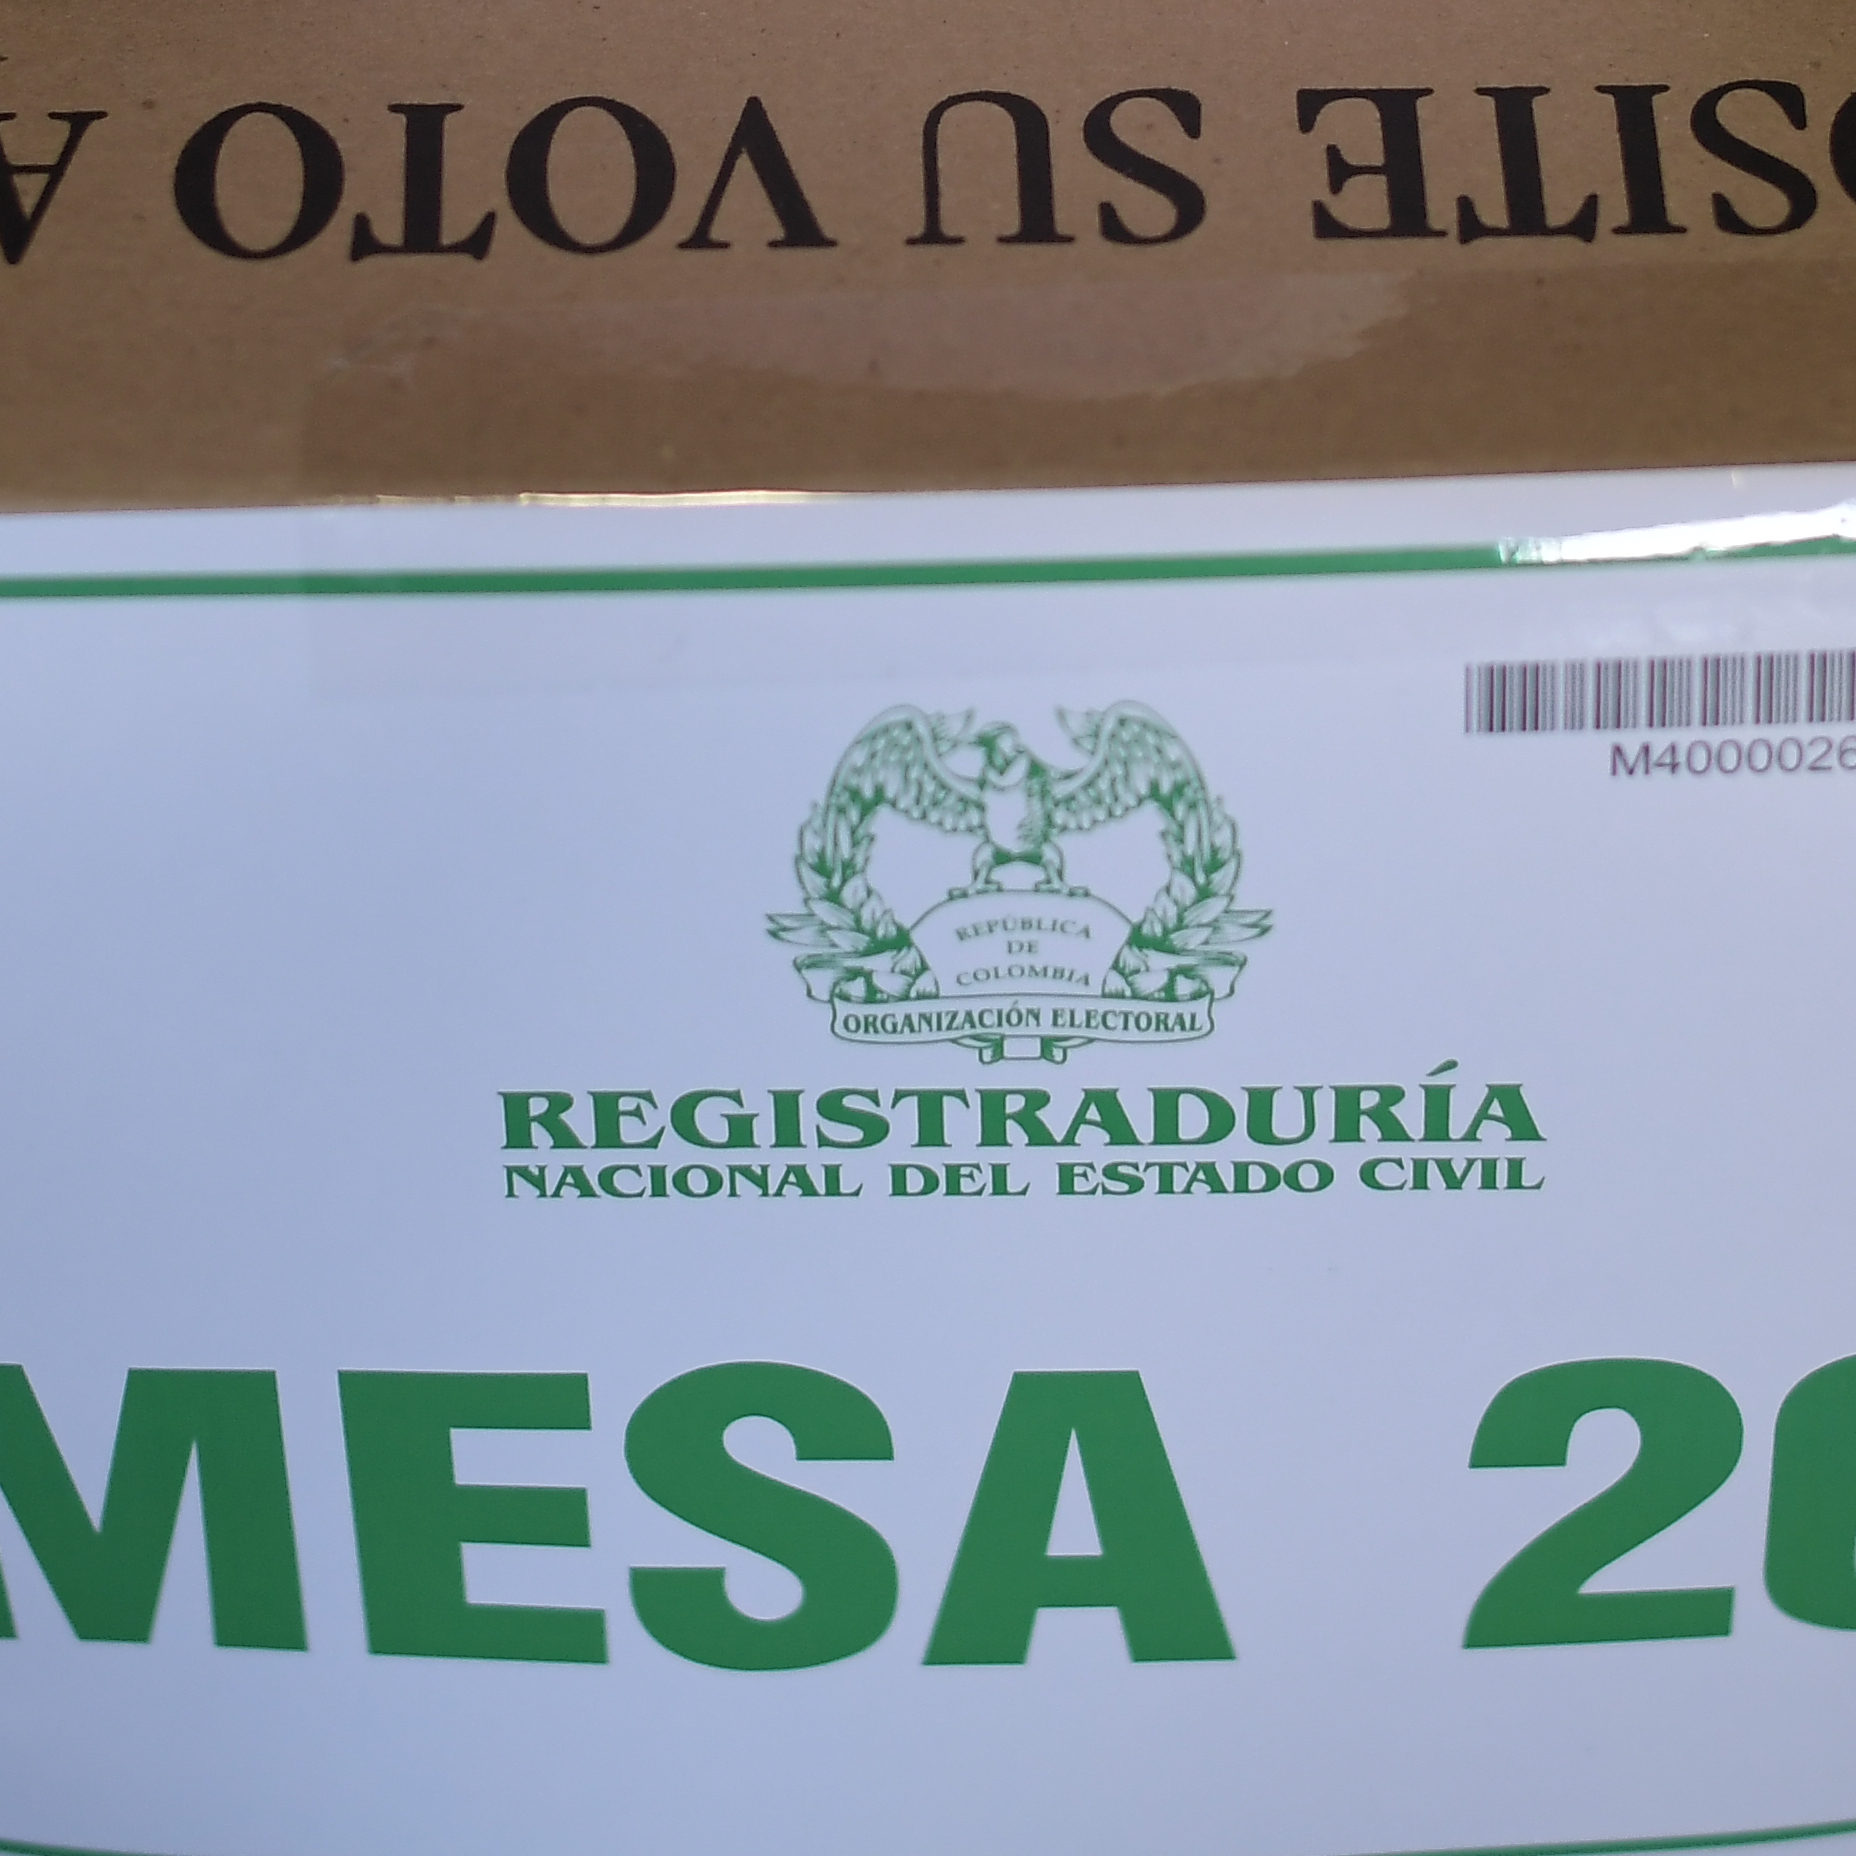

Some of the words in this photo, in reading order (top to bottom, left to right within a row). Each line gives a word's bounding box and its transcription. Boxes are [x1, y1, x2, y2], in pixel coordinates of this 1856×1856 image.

[173, 96, 838, 263] VOTO
[905, 88, 1206, 246] SU
[955, 912, 1092, 943] REPÚBLICA
[1006, 939, 1040, 956] DE
[955, 963, 1092, 988] COLOMBIA
[843, 1000, 1042, 1037] ORGANIZACIÓN
[1050, 1006, 1204, 1033] ELECTORAL
[499, 1058, 1547, 1149] REGISTRADURÍA
[503, 1162, 863, 1202] NACIONAL
[889, 1160, 1030, 1198] DEL
[1056, 1156, 1336, 1195] ESTADO
[1358, 1154, 1546, 1193] CIVIL
